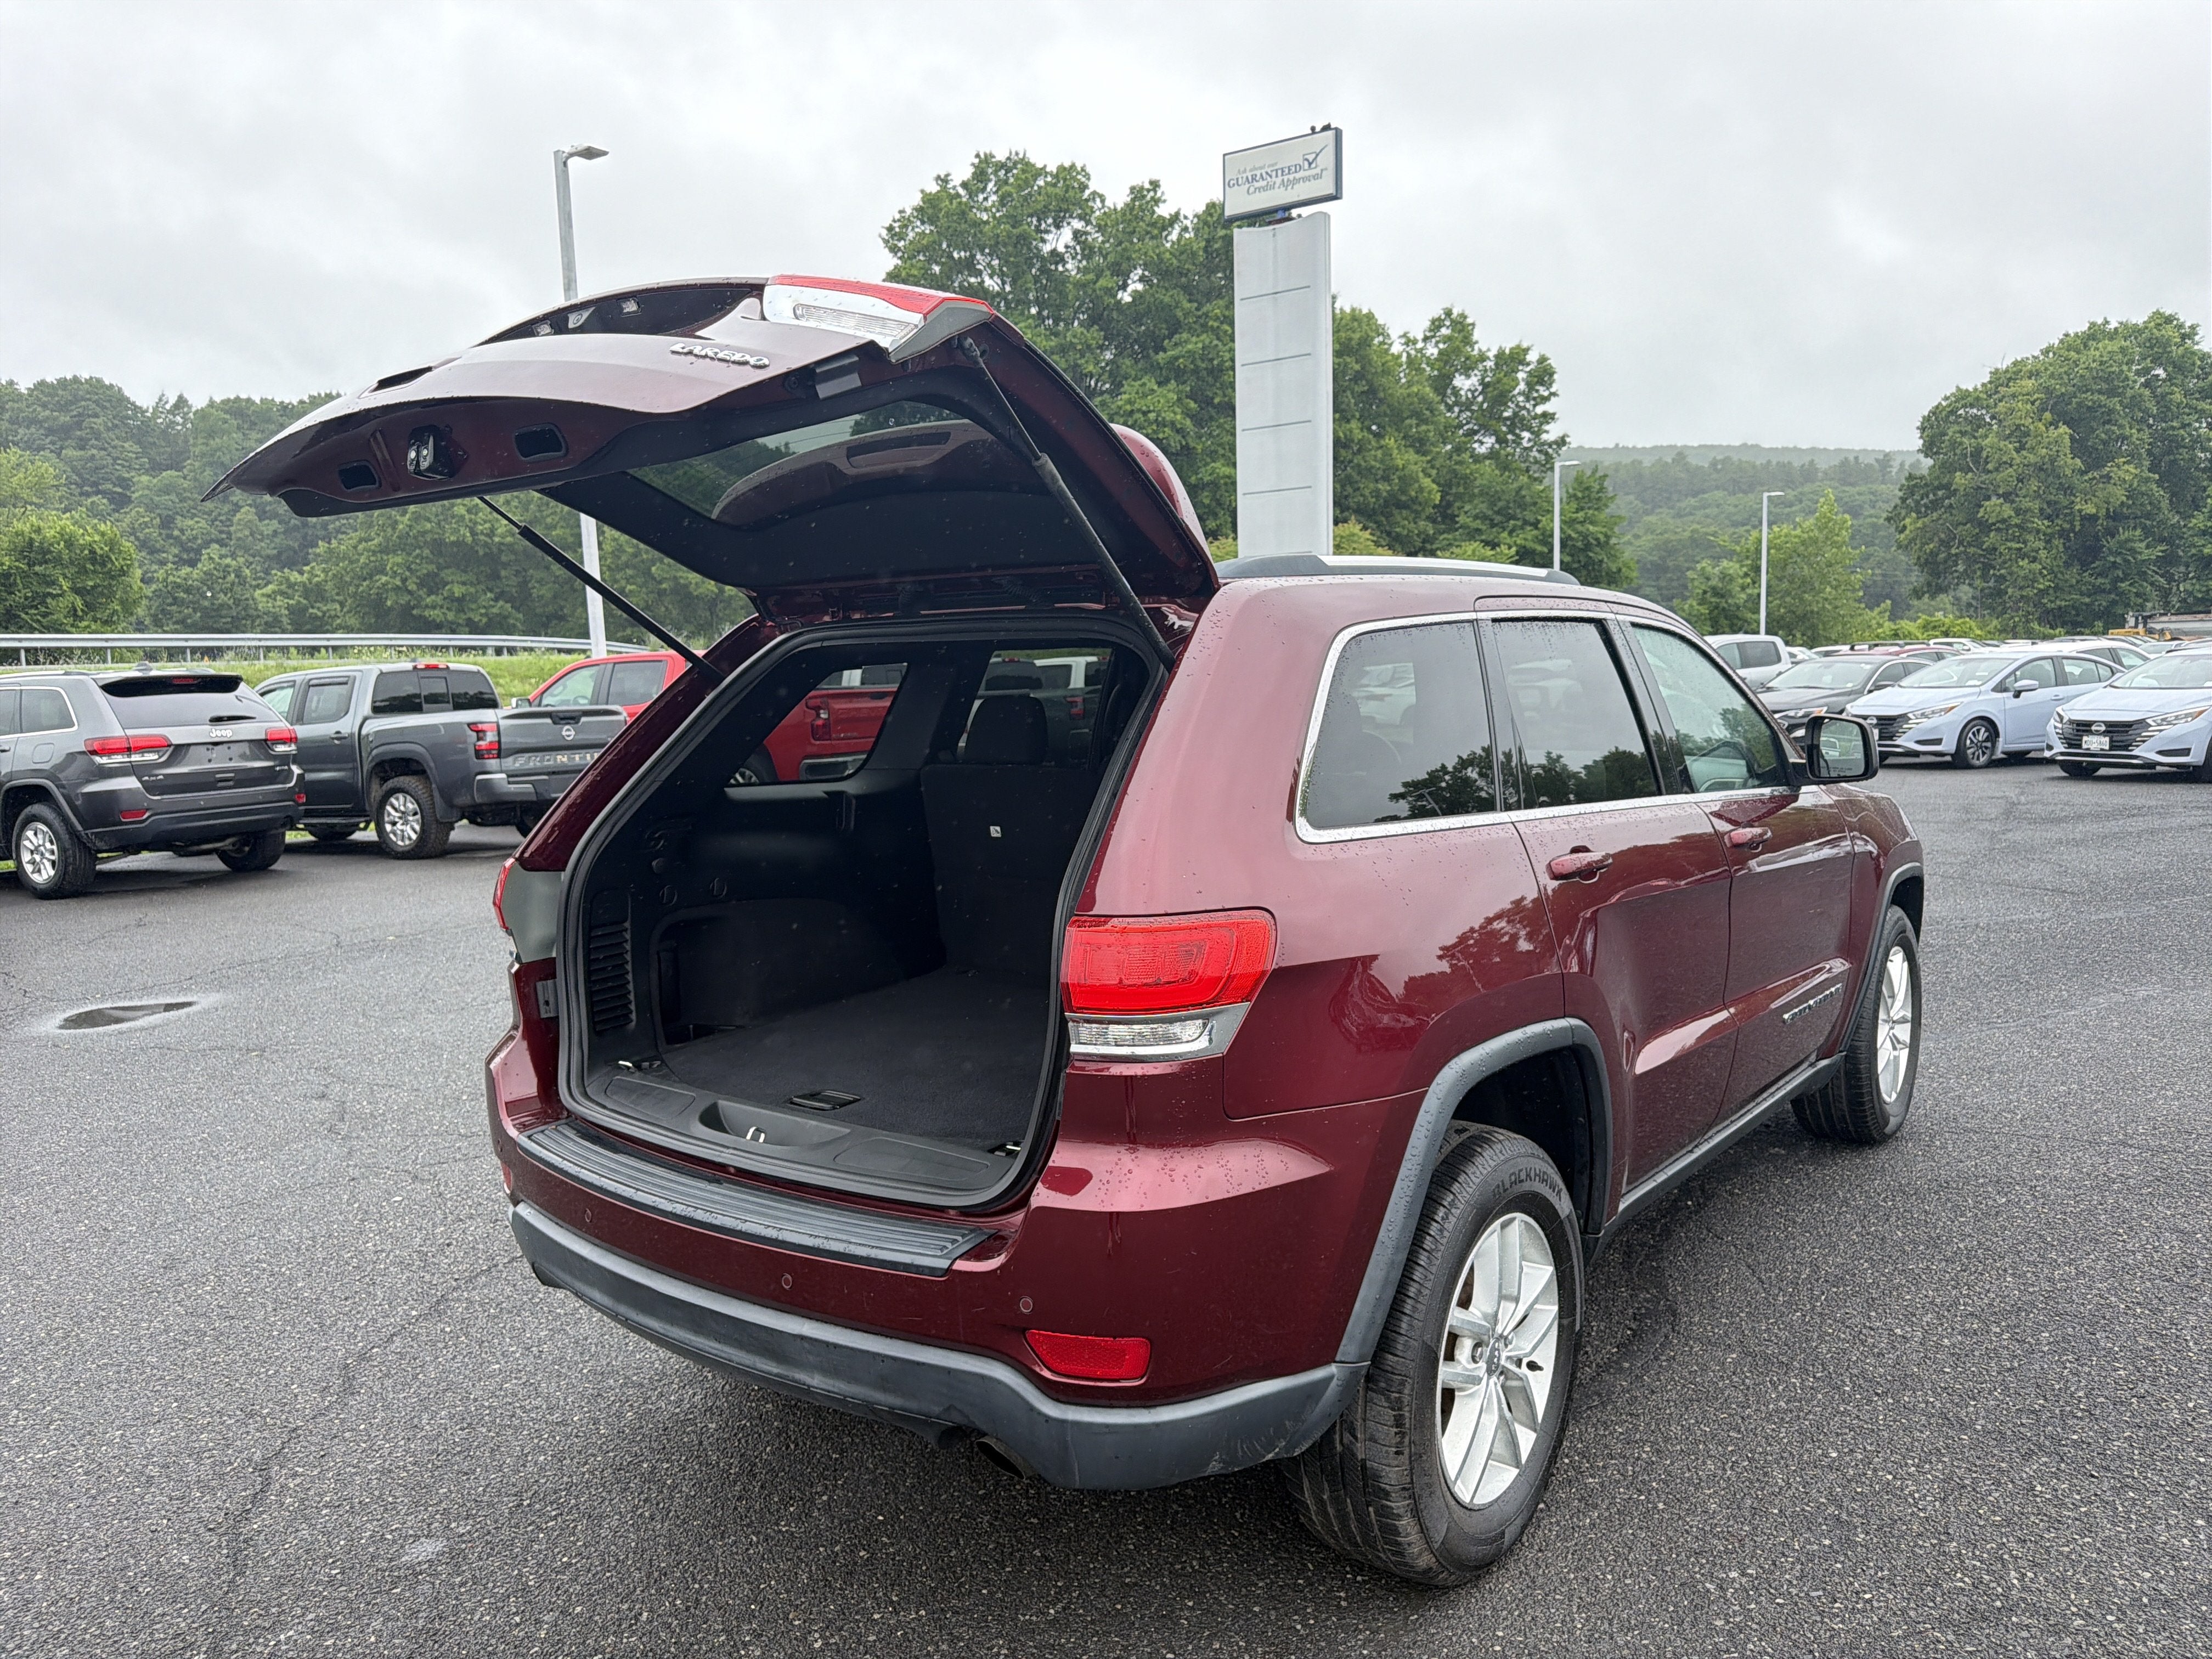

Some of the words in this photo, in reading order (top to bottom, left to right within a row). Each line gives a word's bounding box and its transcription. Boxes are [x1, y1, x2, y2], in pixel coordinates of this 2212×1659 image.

[1227, 163, 1302, 188] GUARANTEED
[1246, 180, 1276, 195] Credit
[669, 343, 770, 369] LAREDO
[210, 729, 233, 737] Jeep
[1492, 1166, 1562, 1202] BLACKHAWK
